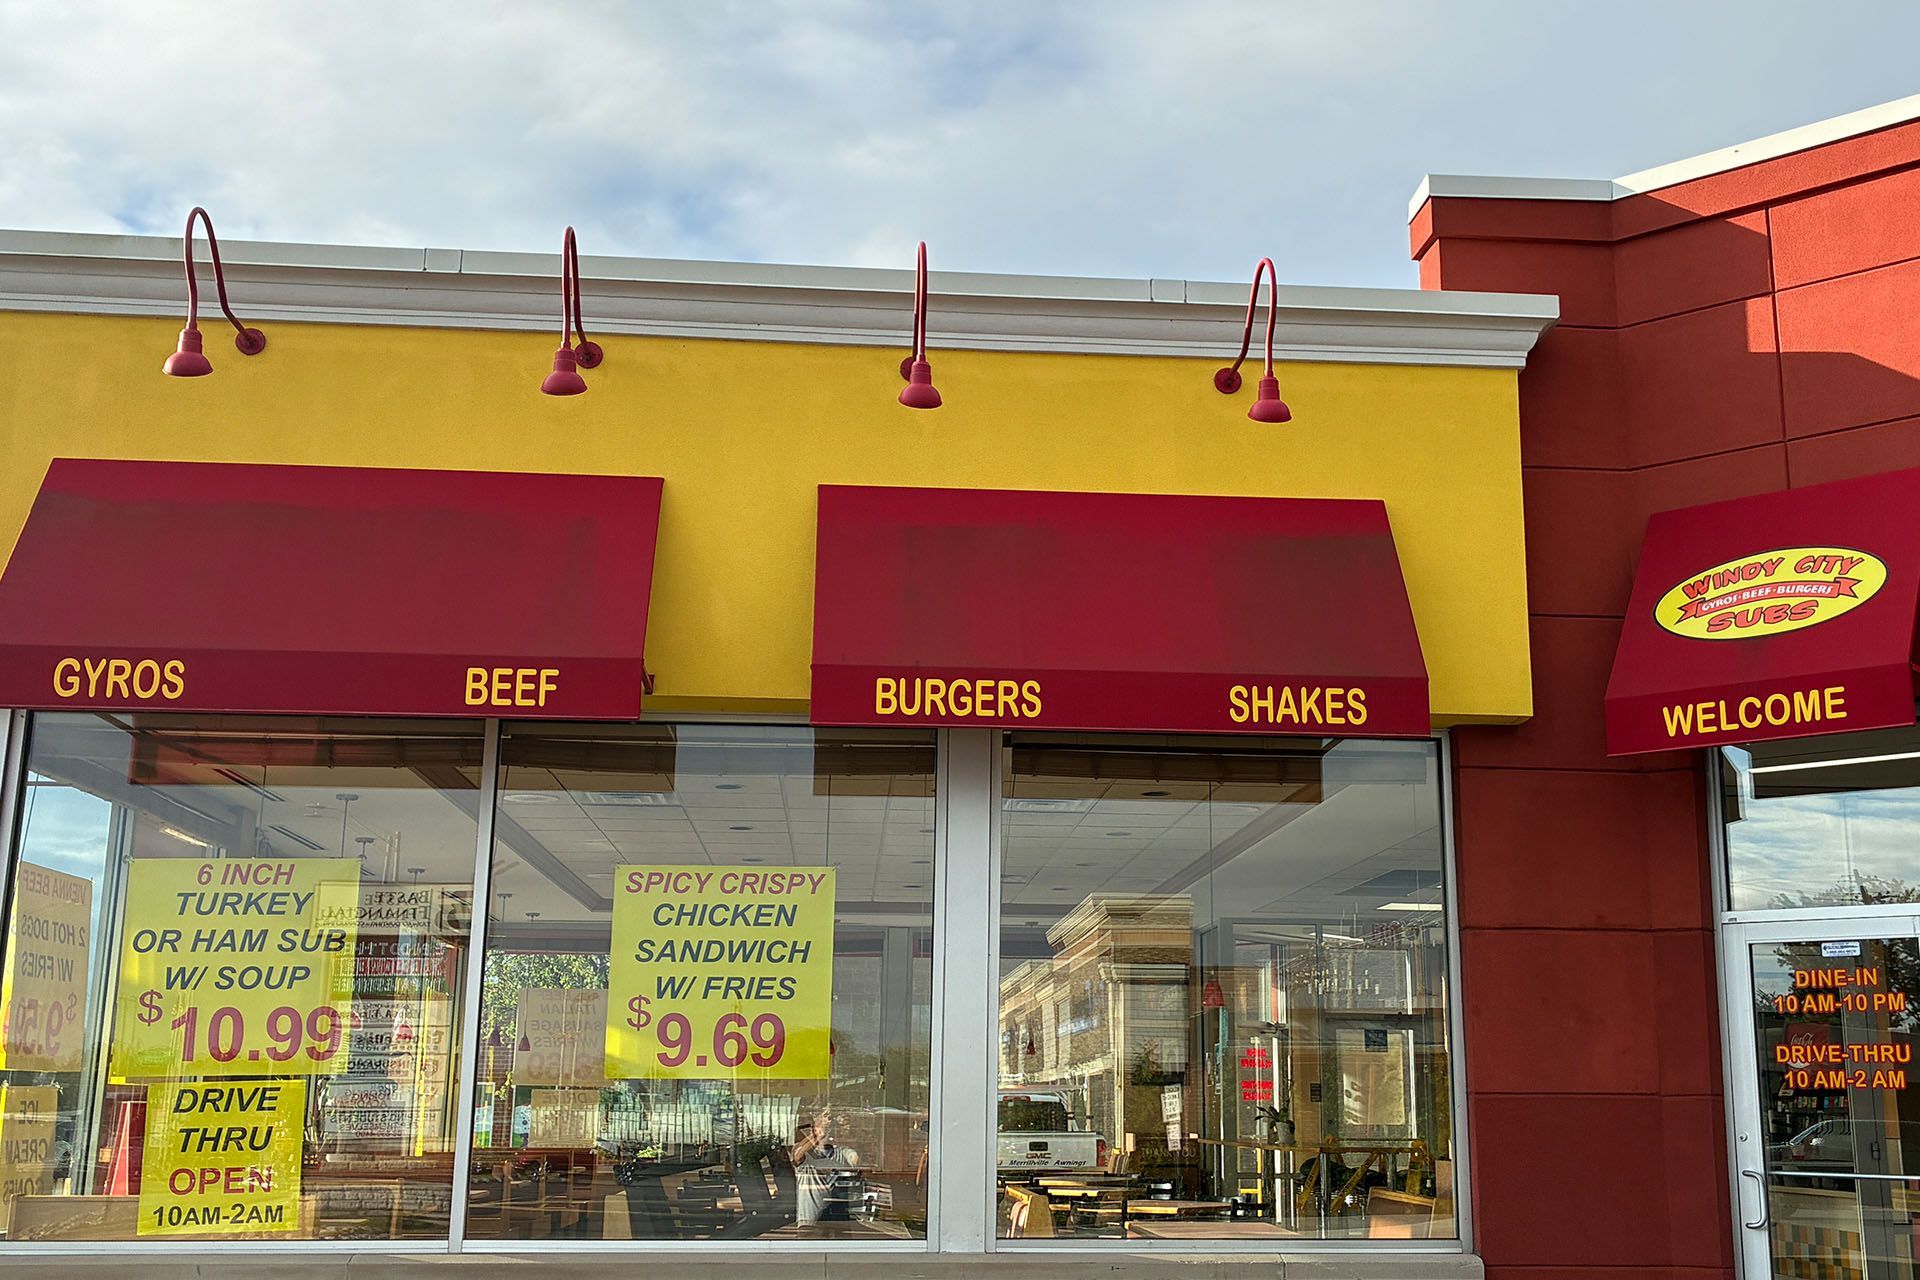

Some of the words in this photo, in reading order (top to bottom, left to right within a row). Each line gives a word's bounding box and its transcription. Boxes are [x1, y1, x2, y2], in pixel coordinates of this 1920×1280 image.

[1682, 557, 1785, 599] WINDY
[1794, 555, 1864, 575] CITY
[1707, 600, 1818, 632] SUBS
[53, 657, 185, 699] GYROS
[465, 667, 560, 707] BEEF
[876, 677, 1042, 718] BURGERS
[1229, 685, 1367, 726] SHAKES
[1662, 686, 1848, 737] WELCOME
[197, 863, 213, 885] 6
[221, 863, 296, 886] INCH
[625, 872, 714, 894] SPICY
[719, 872, 826, 895] CRISPY
[177, 892, 314, 916] TURKEY
[653, 903, 798, 927] CHICKEN
[132, 928, 182, 953] OR
[191, 929, 269, 953] HAM
[277, 928, 346, 953] SUB
[635, 939, 811, 963] SANDWICH
[165, 966, 208, 990] W/
[214, 966, 311, 990] SOUP
[656, 976, 697, 1000] W/
[702, 976, 797, 1000] FRIES
[1795, 968, 1878, 988] DINE-IN
[1774, 994, 1798, 1013] 10
[1803, 993, 1868, 1012] AM-10
[1873, 992, 1906, 1011] PM
[656, 1012, 786, 1068] 9.69
[1776, 1044, 1911, 1063] DRIVE-THRU
[1784, 1070, 1809, 1088] 10
[1814, 1070, 1867, 1088] AM-2
[1872, 1070, 1906, 1088] AM
[172, 1087, 281, 1113] DRIVE
[178, 1126, 273, 1152] THRU
[1025, 1152, 1052, 1160] GMC
[168, 1166, 272, 1195] OPEN
[153, 1203, 283, 1226] 10AM-2AM
